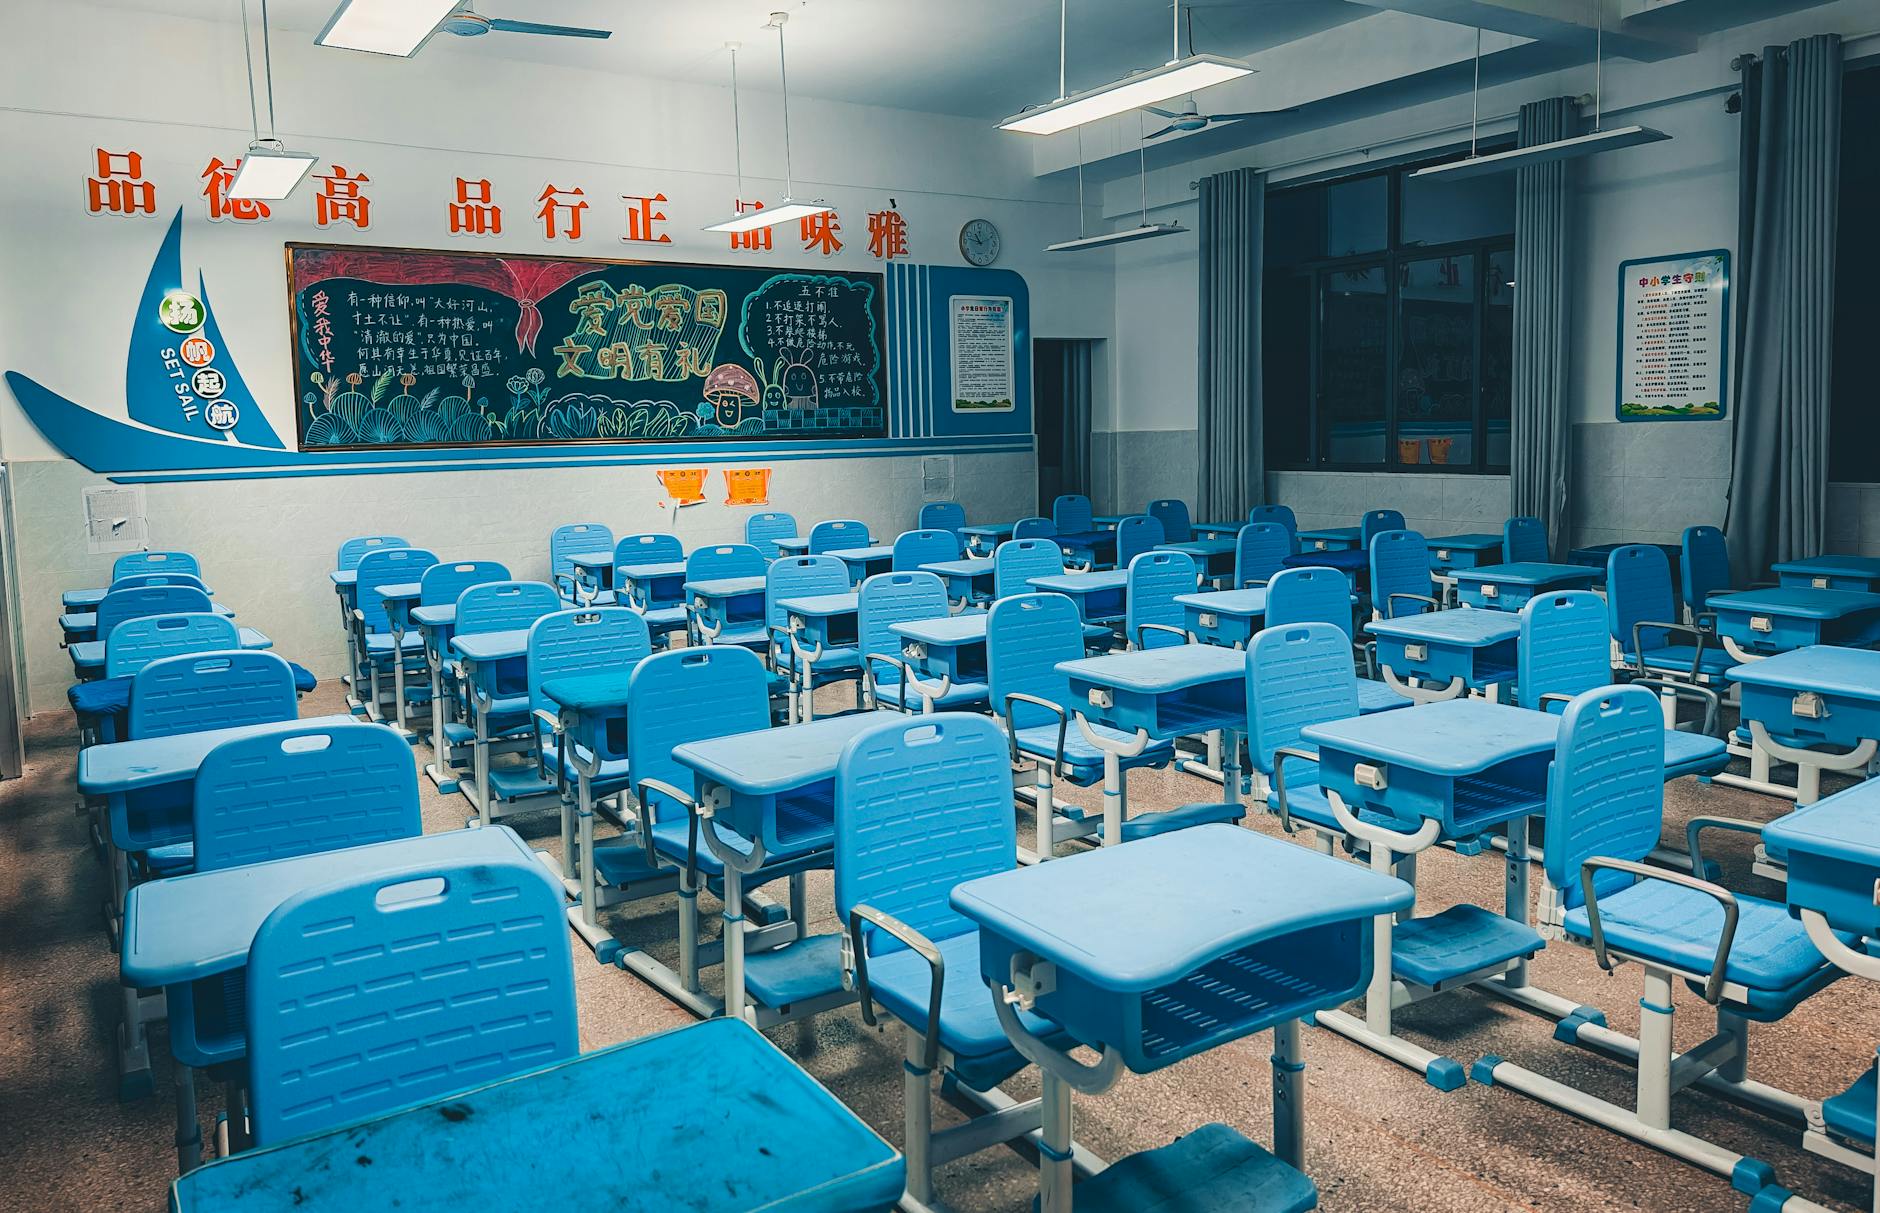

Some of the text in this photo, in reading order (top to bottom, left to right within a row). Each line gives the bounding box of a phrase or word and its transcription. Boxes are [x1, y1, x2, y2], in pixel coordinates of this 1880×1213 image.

[449, 176, 672, 243] 品行正
[569, 280, 728, 336] 爱党爱国
[1639, 271, 1706, 288] 中小学生守则
[168, 293, 235, 425] 扬帆起航
[311, 289, 336, 374] 爱我中华
[553, 335, 712, 382] 文明有礼
[160, 347, 201, 423] SET SAIL
